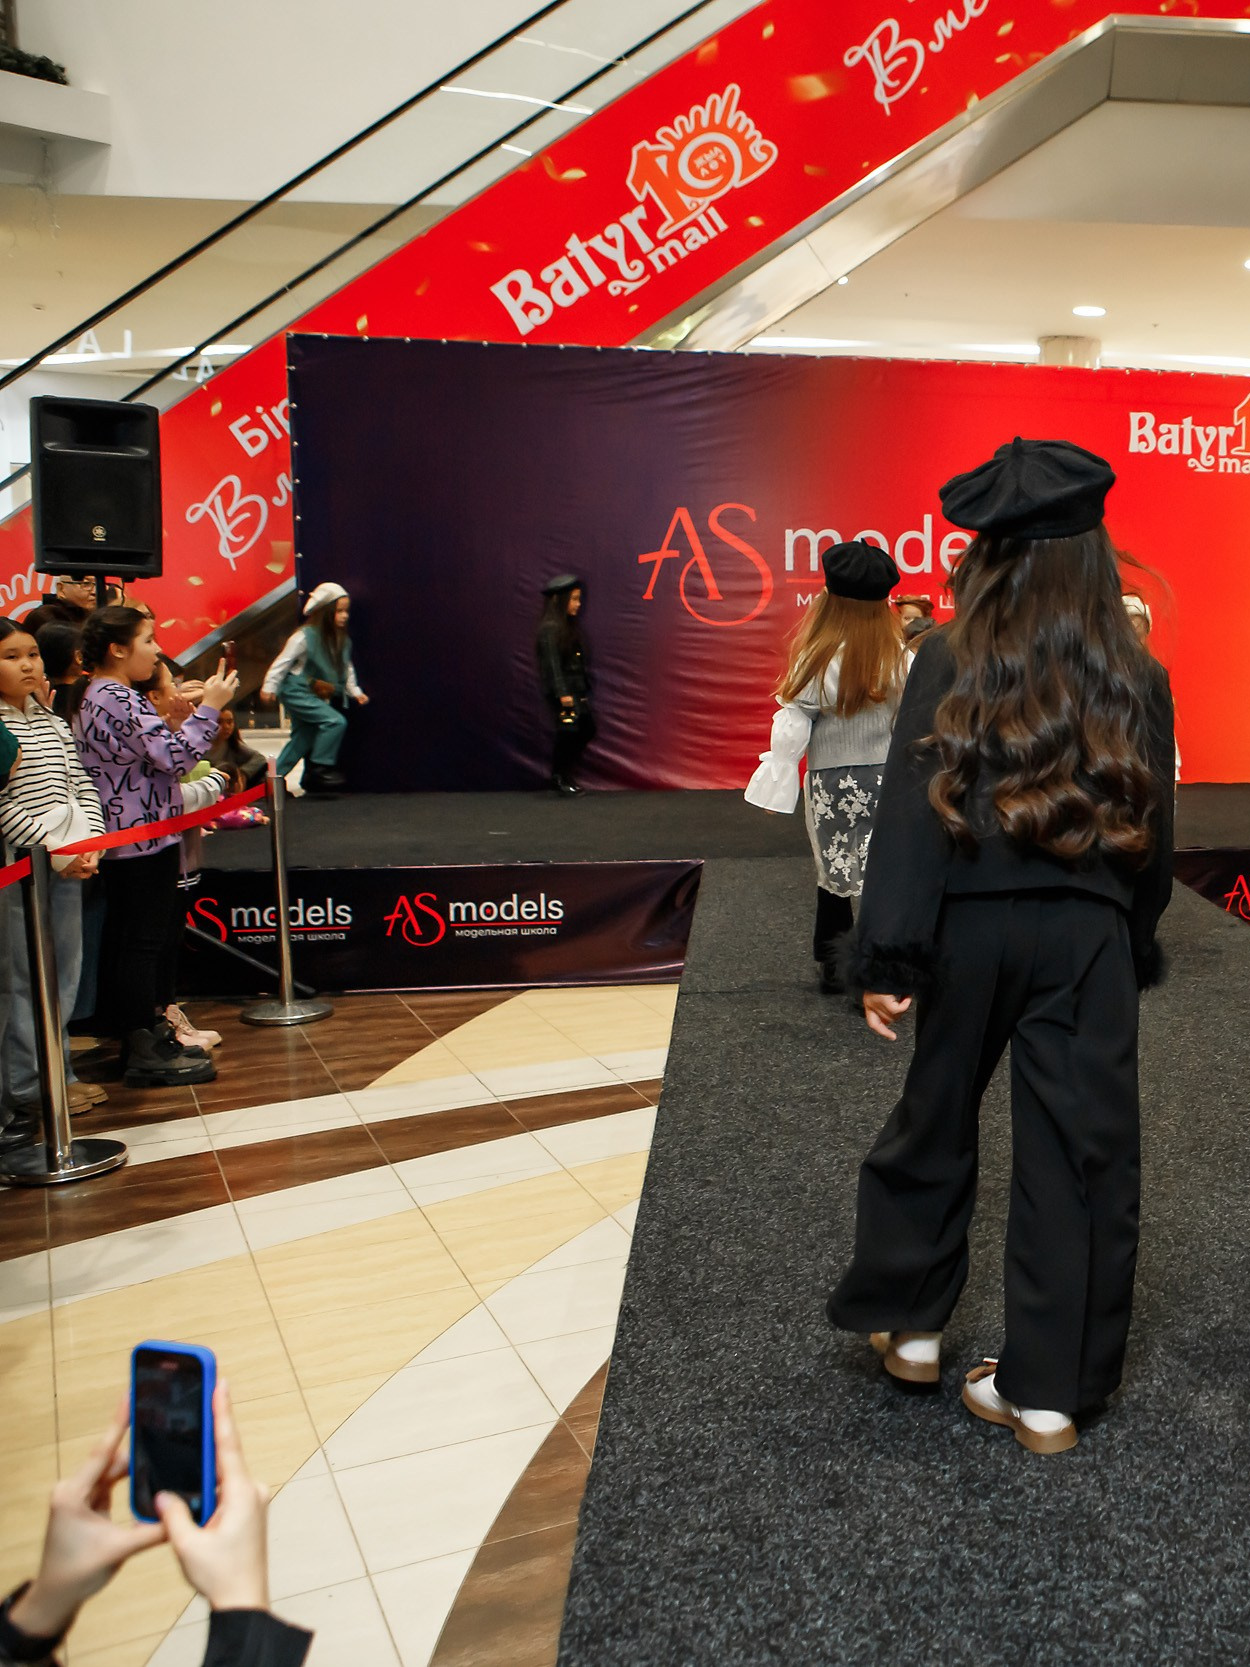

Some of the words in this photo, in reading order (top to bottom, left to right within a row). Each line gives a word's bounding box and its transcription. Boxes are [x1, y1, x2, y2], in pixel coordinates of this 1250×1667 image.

[647, 206, 728, 274] mall
[489, 204, 655, 336] Batyr
[1128, 411, 1236, 473] Batyr
[637, 502, 774, 627] AS
[230, 897, 352, 928] models
[307, 932, 346, 942] школа
[383, 892, 446, 947] AS
[449, 892, 564, 922] models
[455, 928, 518, 939] модельная
[520, 927, 557, 936] школа
